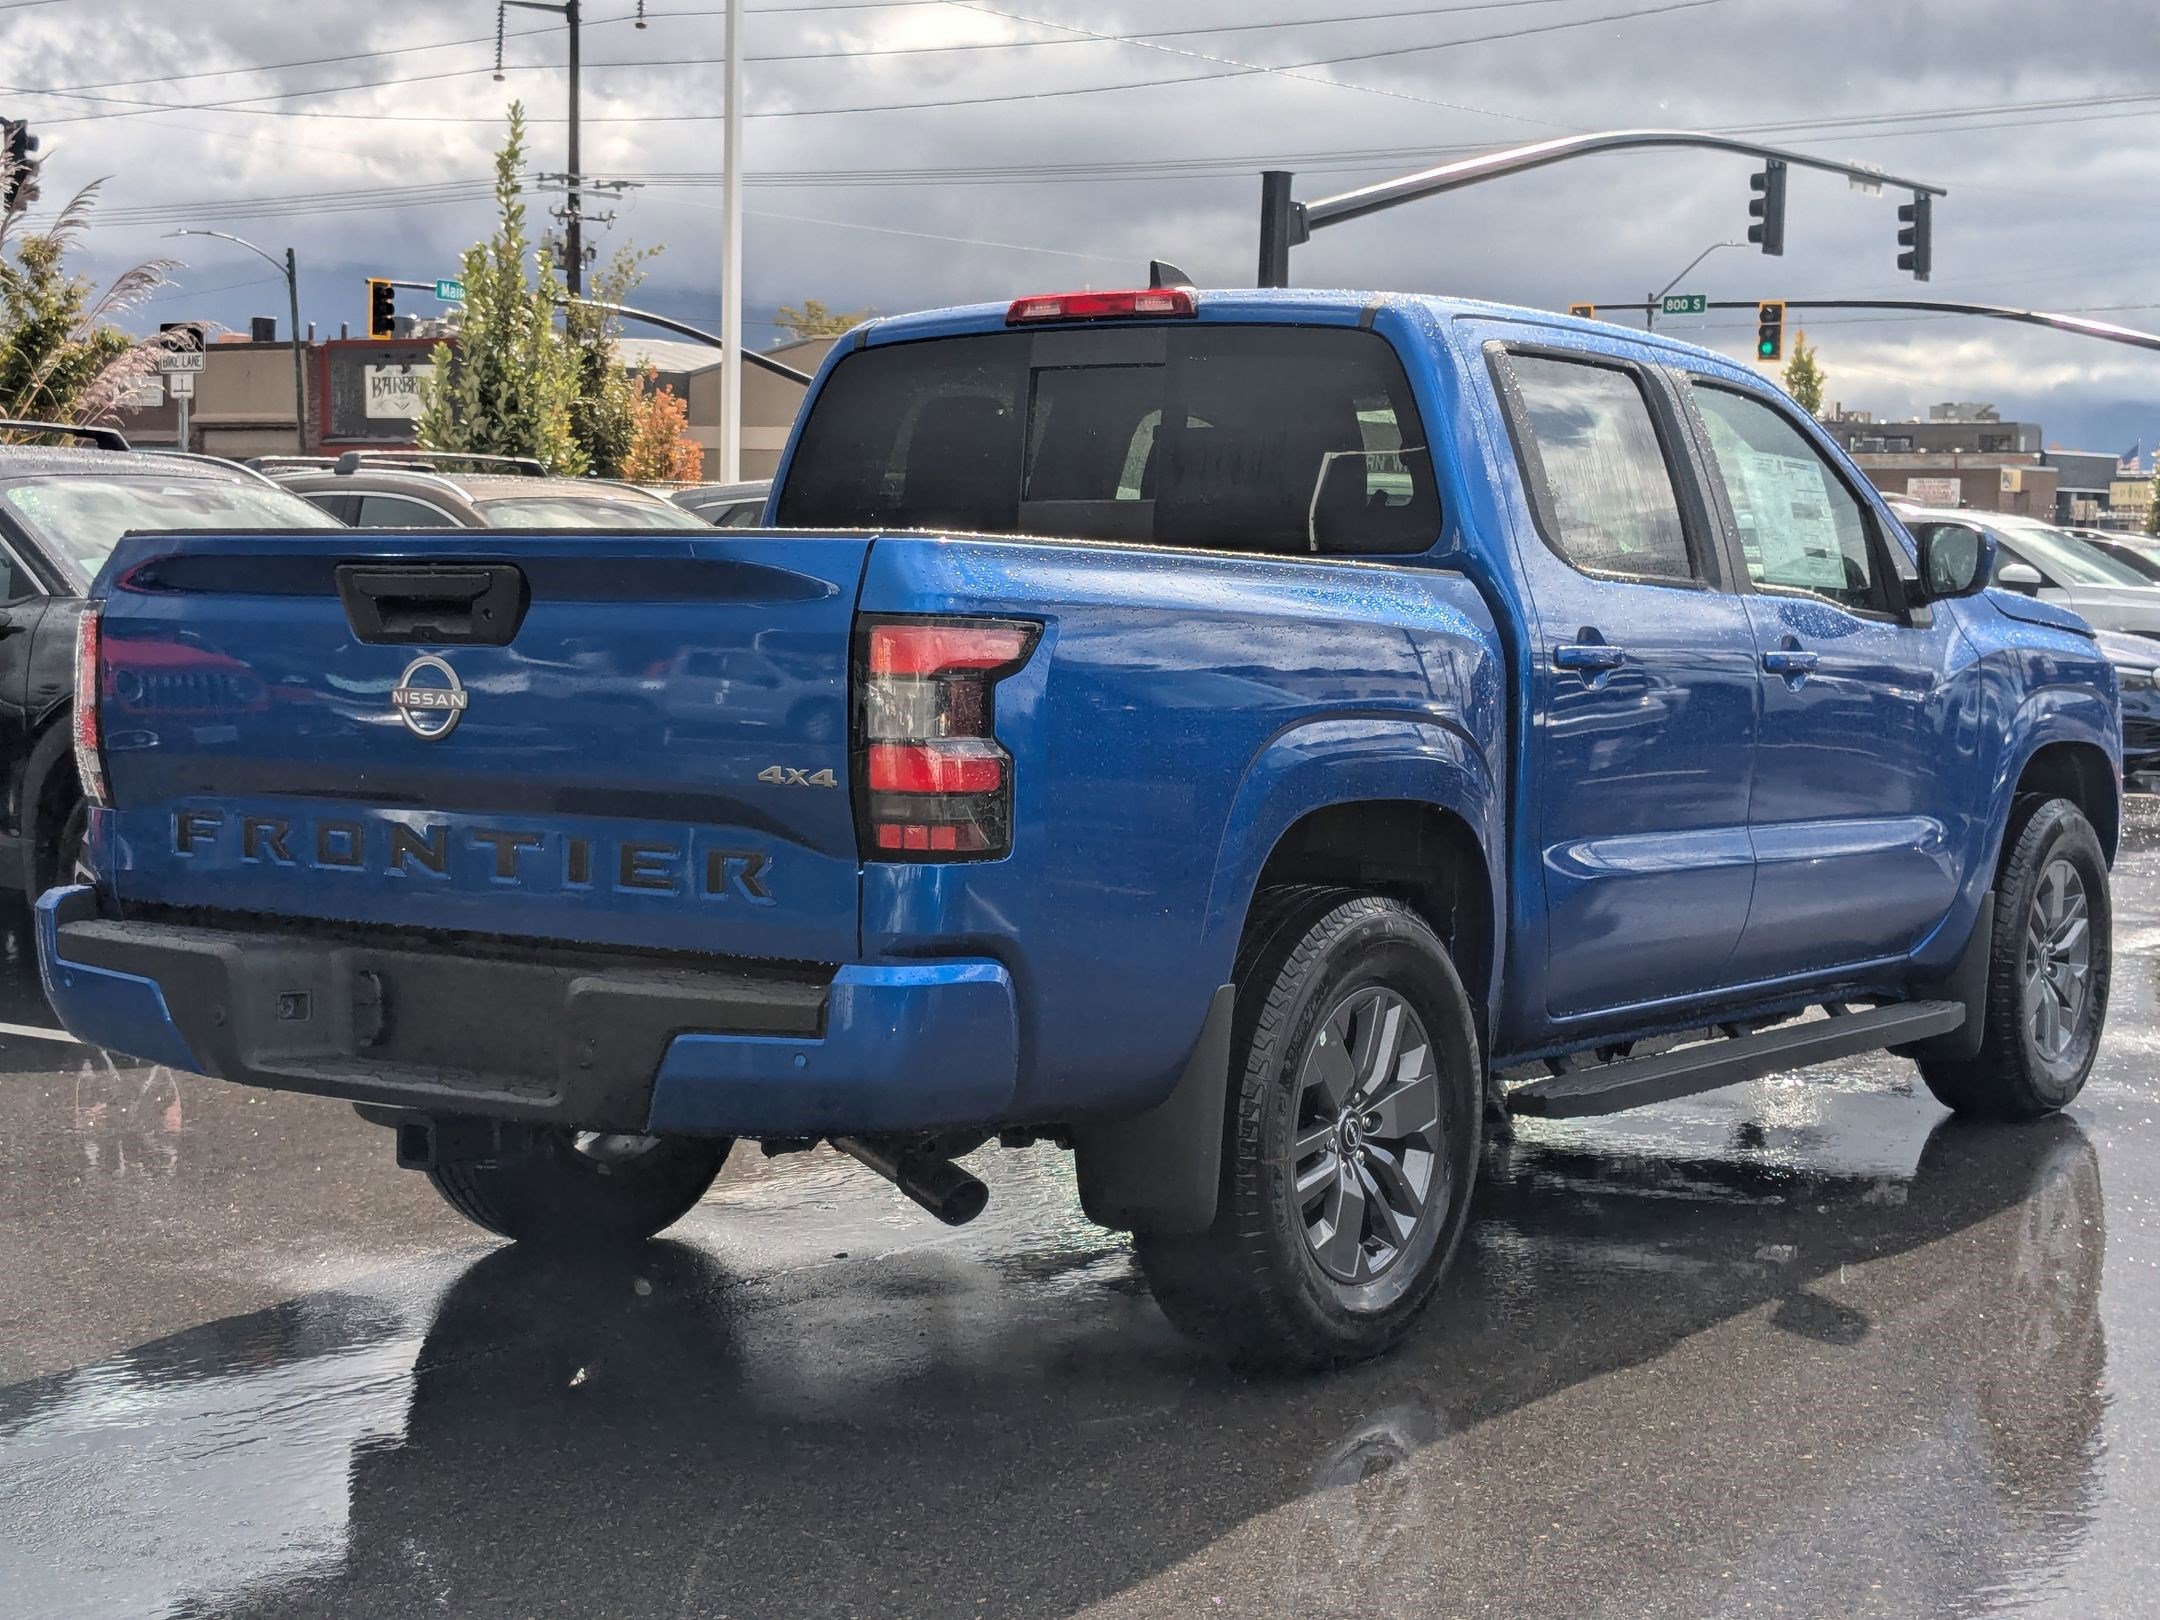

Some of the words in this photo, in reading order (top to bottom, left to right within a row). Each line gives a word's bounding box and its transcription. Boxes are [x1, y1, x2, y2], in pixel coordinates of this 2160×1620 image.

[1667, 299, 1688, 311] 800
[1693, 298, 1701, 310] S
[182, 355, 201, 368] LANE
[393, 691, 465, 707] NISSAN
[172, 808, 776, 904] FRONTIER
